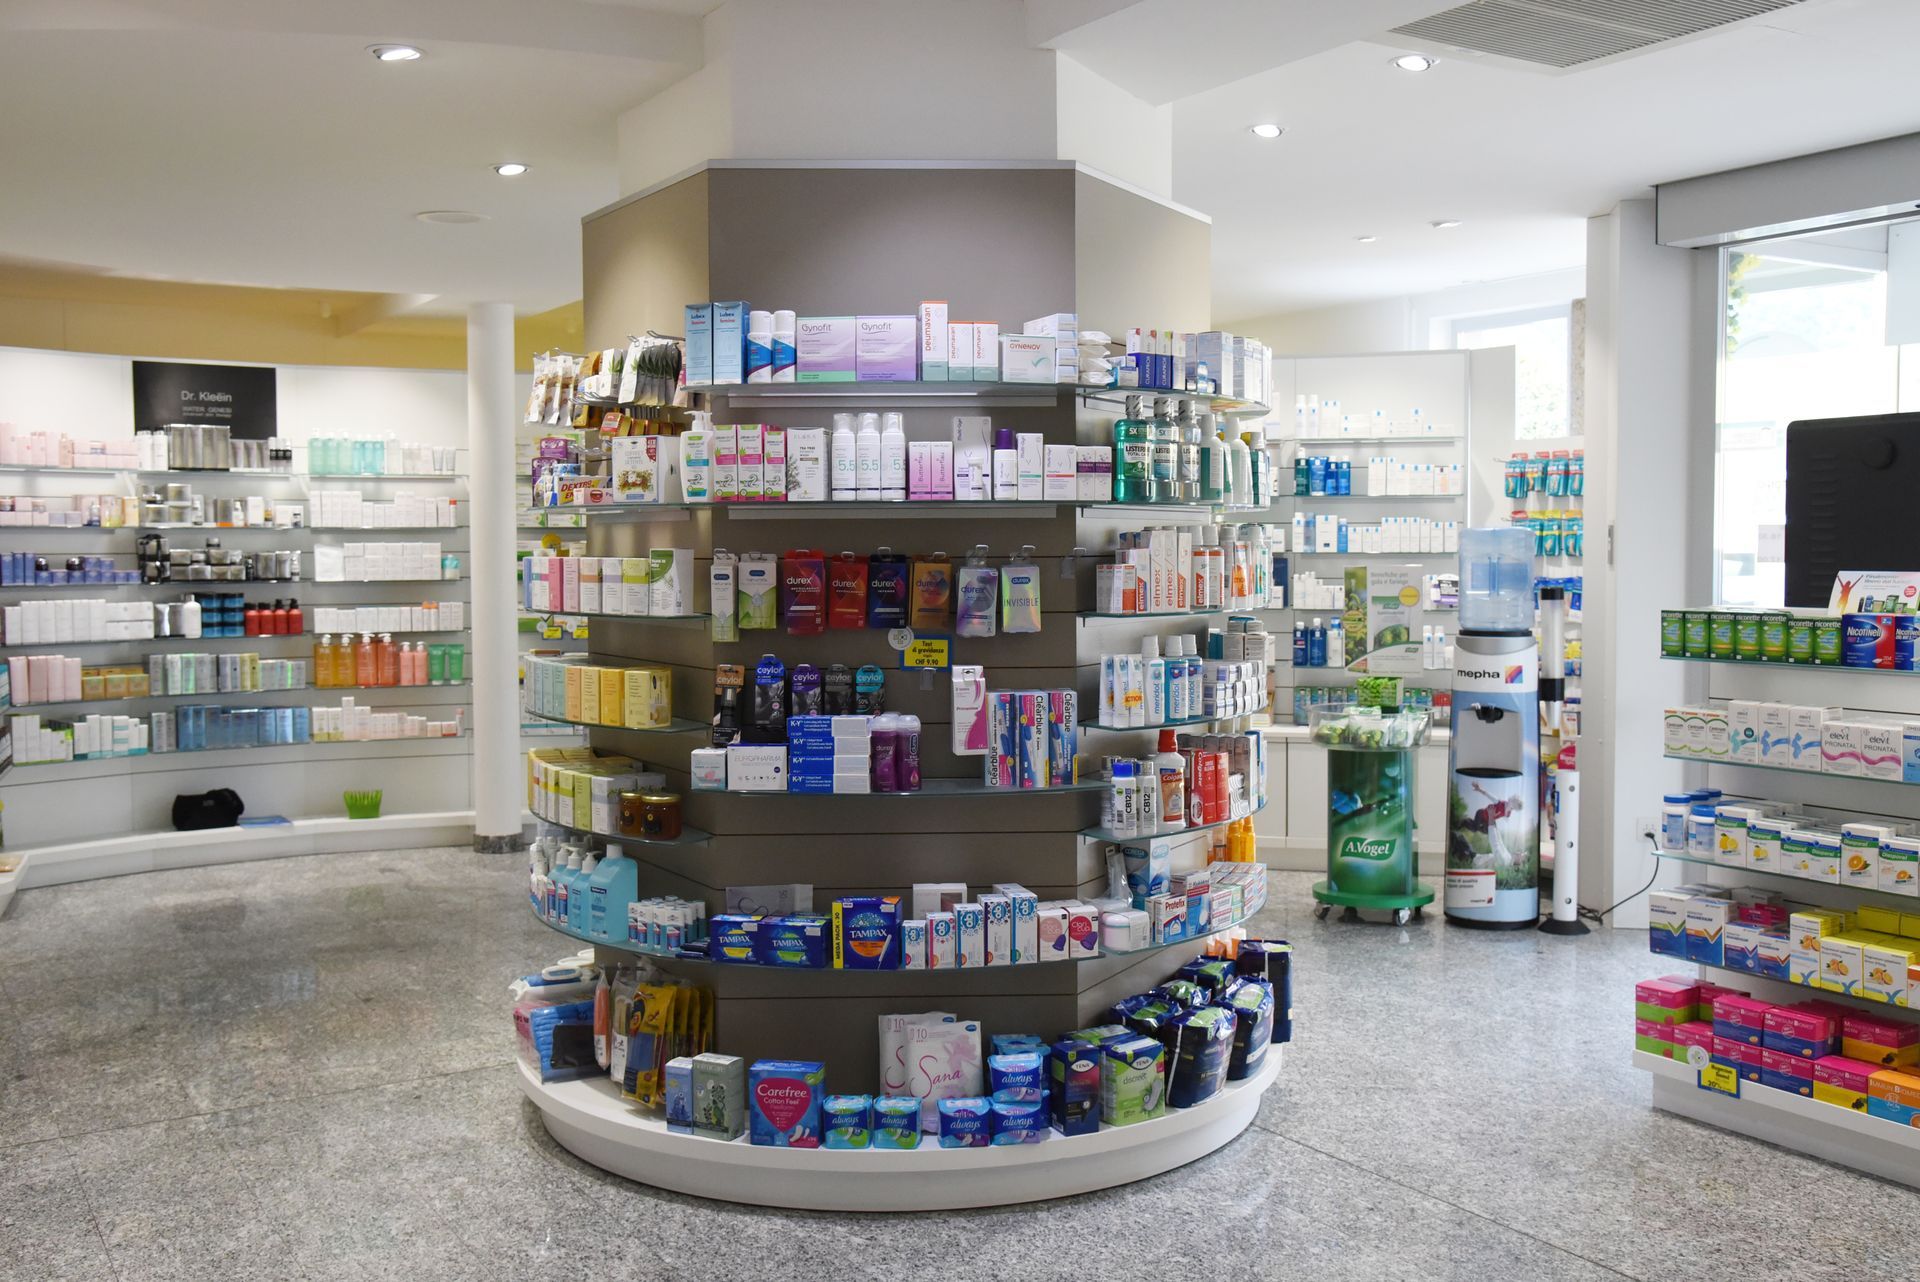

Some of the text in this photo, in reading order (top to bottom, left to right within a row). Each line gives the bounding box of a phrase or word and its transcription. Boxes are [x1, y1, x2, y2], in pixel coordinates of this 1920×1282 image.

[802, 323, 832, 333] Gynofit
[861, 322, 892, 332] Gynofit
[181, 390, 196, 401] Dr.
[861, 460, 879, 471] 5.5
[786, 577, 812, 585] durex
[832, 579, 857, 588] durex
[871, 579, 896, 588] durex
[1003, 597, 1039, 607] INVISIBLE
[757, 666, 783, 676] ceylor
[1457, 669, 1500, 680] mepha
[717, 676, 742, 685] ceylor
[793, 672, 818, 682] ceylor
[826, 673, 851, 682] ceylor
[857, 673, 882, 682] ceylor
[1064, 693, 1072, 733] Clearblue
[1825, 741, 1857, 749] PRONATAL
[1864, 744, 1898, 753] PRONATAL
[1346, 840, 1389, 856] A.Vogel
[1165, 900, 1185, 911] Protefix
[850, 929, 887, 938] TAMPAX
[772, 939, 803, 947] TAMPAX
[916, 1028, 927, 1039] 10
[1075, 1062, 1090, 1070] TENA
[909, 1055, 962, 1099] Sana
[1002, 1074, 1032, 1085] always
[757, 1083, 807, 1097] Carefree
[832, 1115, 859, 1124] always
[881, 1117, 908, 1126] always
[1003, 1117, 1033, 1127] always
[950, 1120, 980, 1130] always
